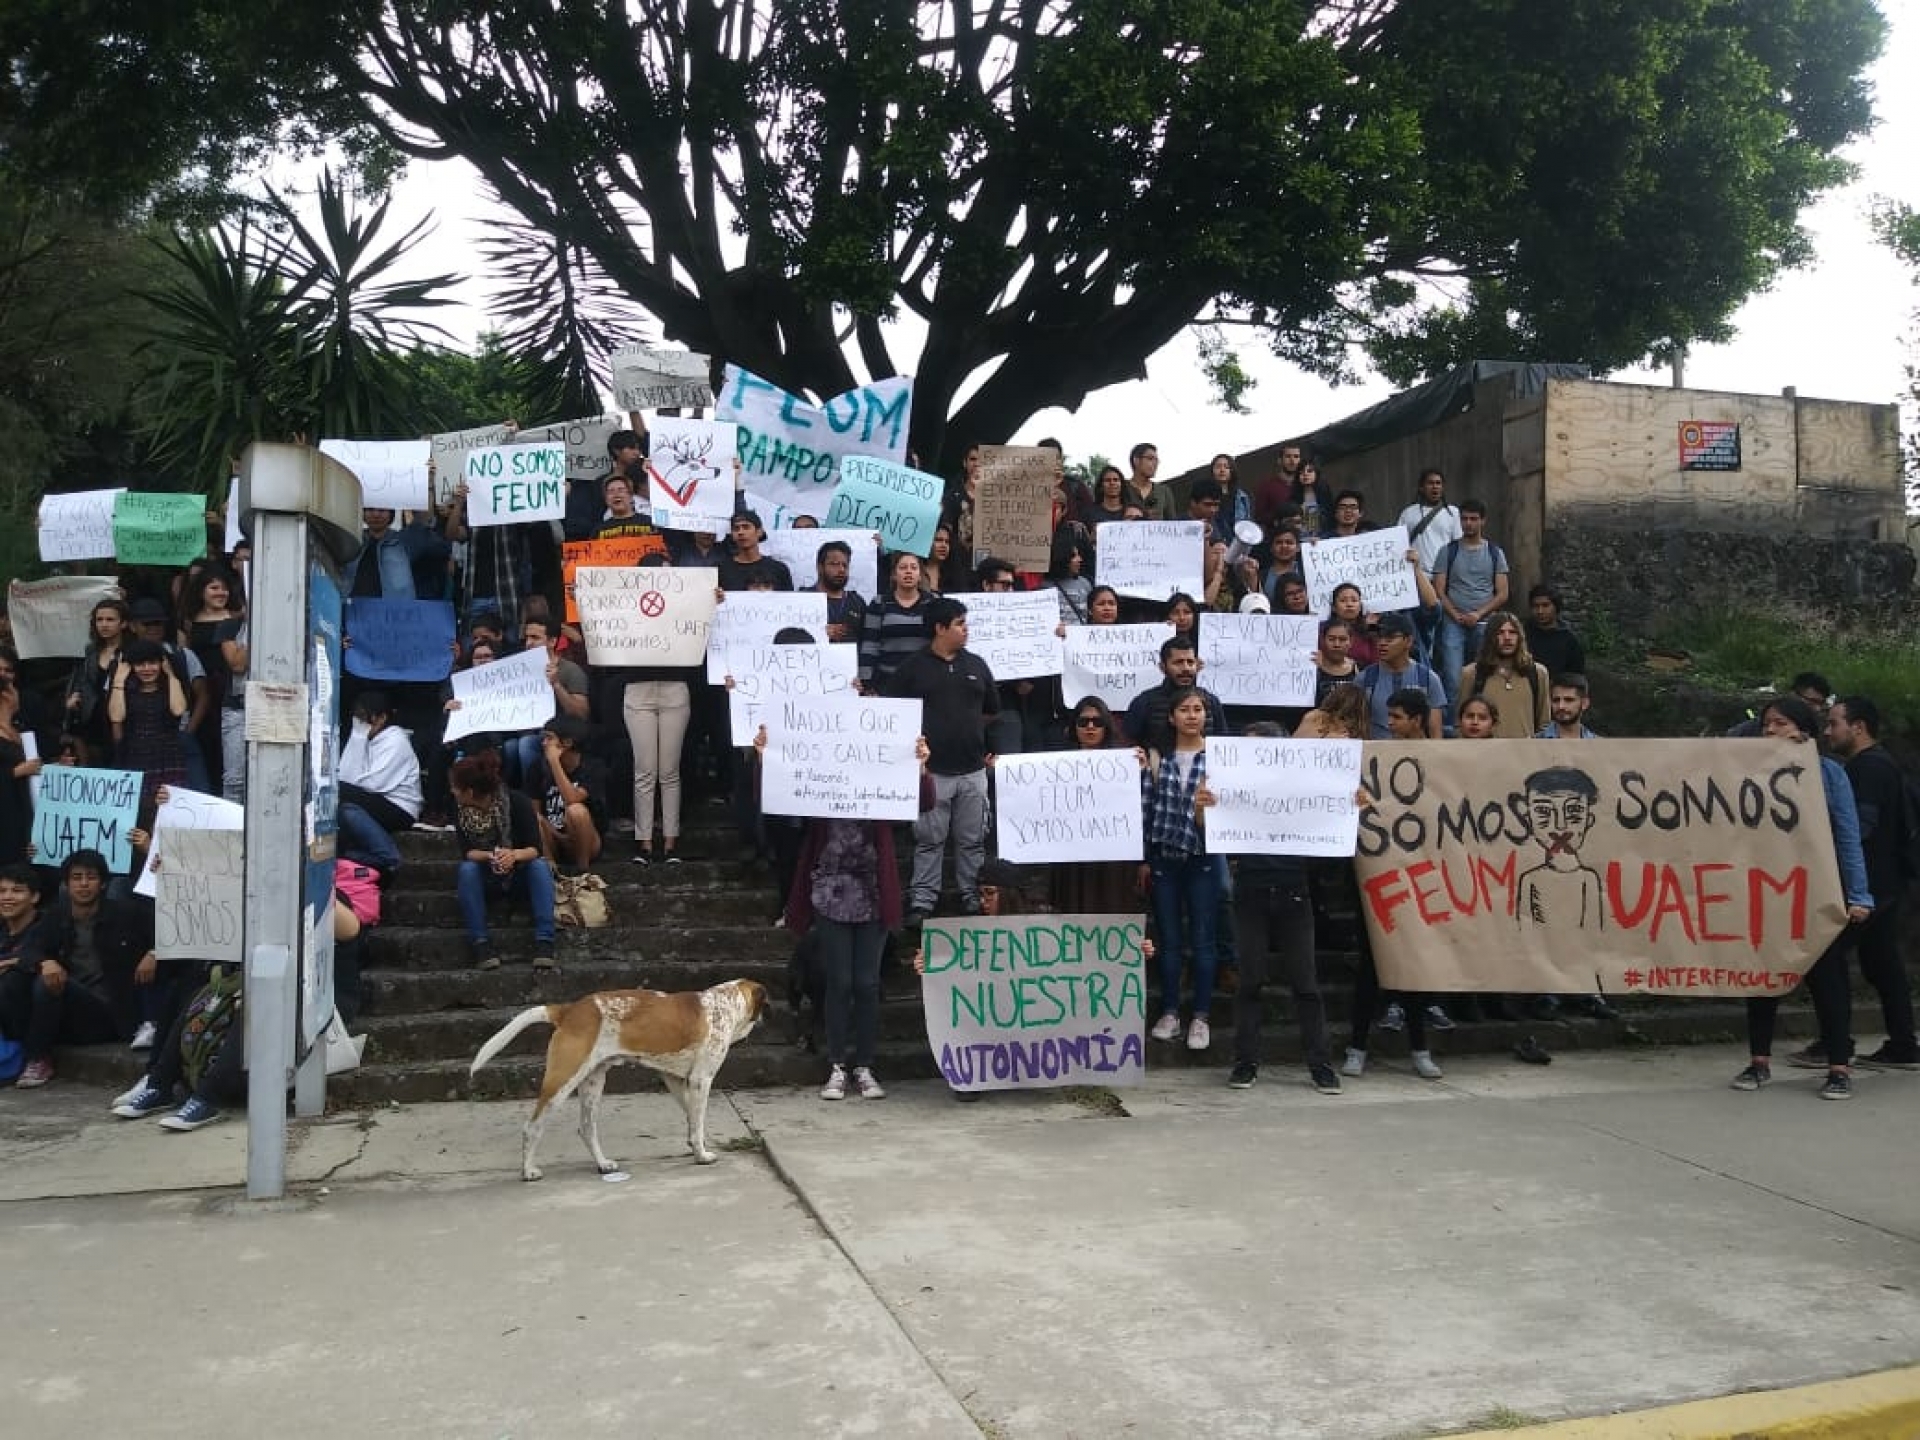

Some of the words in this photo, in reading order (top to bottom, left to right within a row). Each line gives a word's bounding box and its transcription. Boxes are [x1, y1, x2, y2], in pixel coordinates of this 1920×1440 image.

[731, 369, 910, 450] FEUM
[548, 425, 586, 446] NO
[469, 452, 503, 478] NO
[513, 448, 564, 478] SOMOS
[736, 426, 834, 483] RAMPO
[361, 466, 416, 496] UM
[492, 480, 560, 515] FEUM
[836, 494, 918, 542] DIGNO
[1309, 540, 1394, 570] PROTEGER
[578, 571, 605, 589] NO
[618, 570, 684, 592] SOMOS
[752, 649, 821, 671] UAEM
[1239, 646, 1271, 665] LA
[771, 675, 809, 695] NO
[1096, 673, 1136, 689] UAEM
[784, 700, 848, 733] NADIE
[859, 708, 899, 734] QUE
[782, 742, 822, 763] NOS
[834, 743, 895, 765] CALLE
[1006, 762, 1037, 785] NO
[1042, 755, 1129, 784] SOMOS
[1215, 743, 1239, 767] NO
[1254, 745, 1307, 769] SOMOS
[40, 773, 136, 809] AUTONOMÍA
[1219, 787, 1258, 807] OMOS
[1361, 756, 1425, 805] NO
[1616, 762, 1806, 833] SOMOS
[1039, 783, 1096, 813] FEUM
[42, 812, 117, 865] UAEM
[1008, 815, 1074, 848] SOMOS
[1080, 813, 1131, 840] UAEM
[1357, 793, 1533, 857] SOMOS
[1363, 849, 1517, 935] FEUM
[1606, 861, 1808, 952] UAEM
[158, 901, 236, 947] SOMOS
[920, 922, 1143, 974] DEFENDEMOS
[1624, 967, 1802, 990] #INTERFACULTA
[951, 971, 1146, 1029] NUESTRA
[941, 1027, 1144, 1086] AUTONOMÍA
